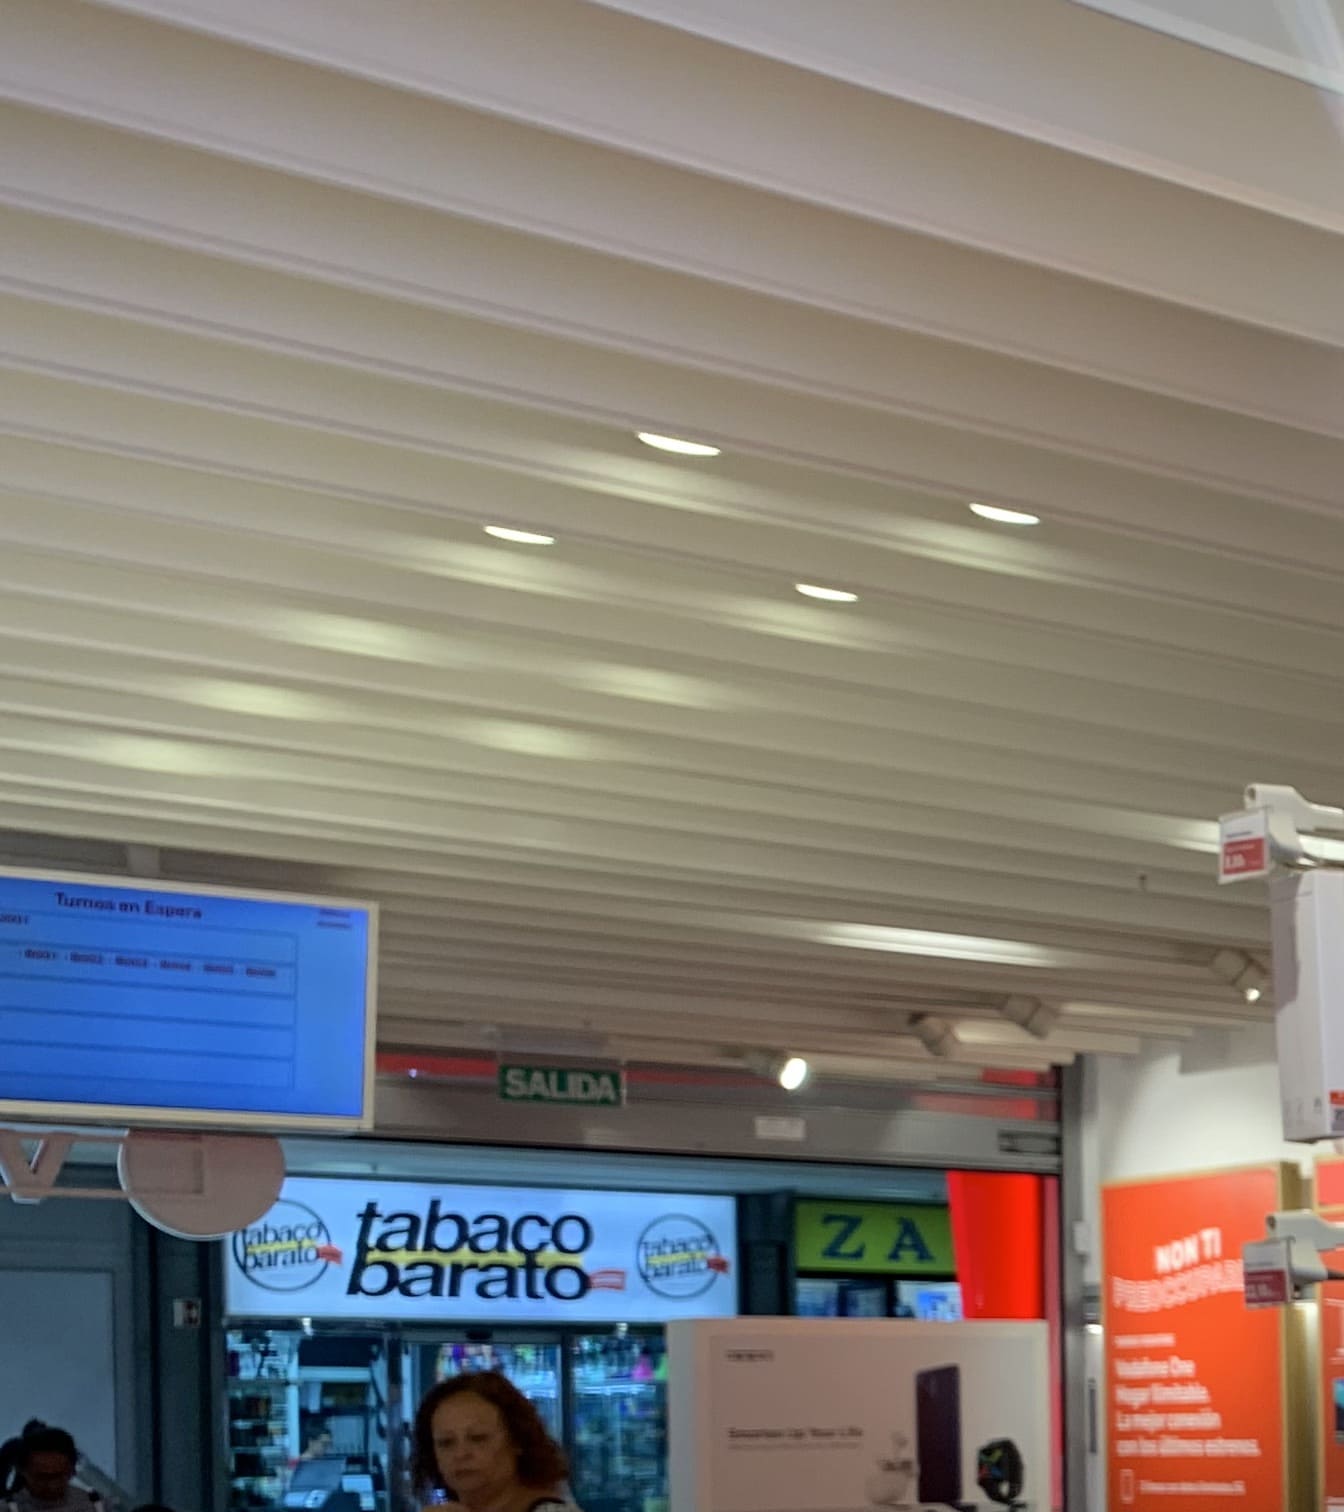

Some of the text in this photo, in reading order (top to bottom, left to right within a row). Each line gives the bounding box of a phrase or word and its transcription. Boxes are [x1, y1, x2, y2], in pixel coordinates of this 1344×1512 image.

[505, 1070, 618, 1102] SALIDA
[357, 1199, 594, 1254] tabaco
[346, 1249, 592, 1300] barato
[1155, 1233, 1199, 1274] NON
